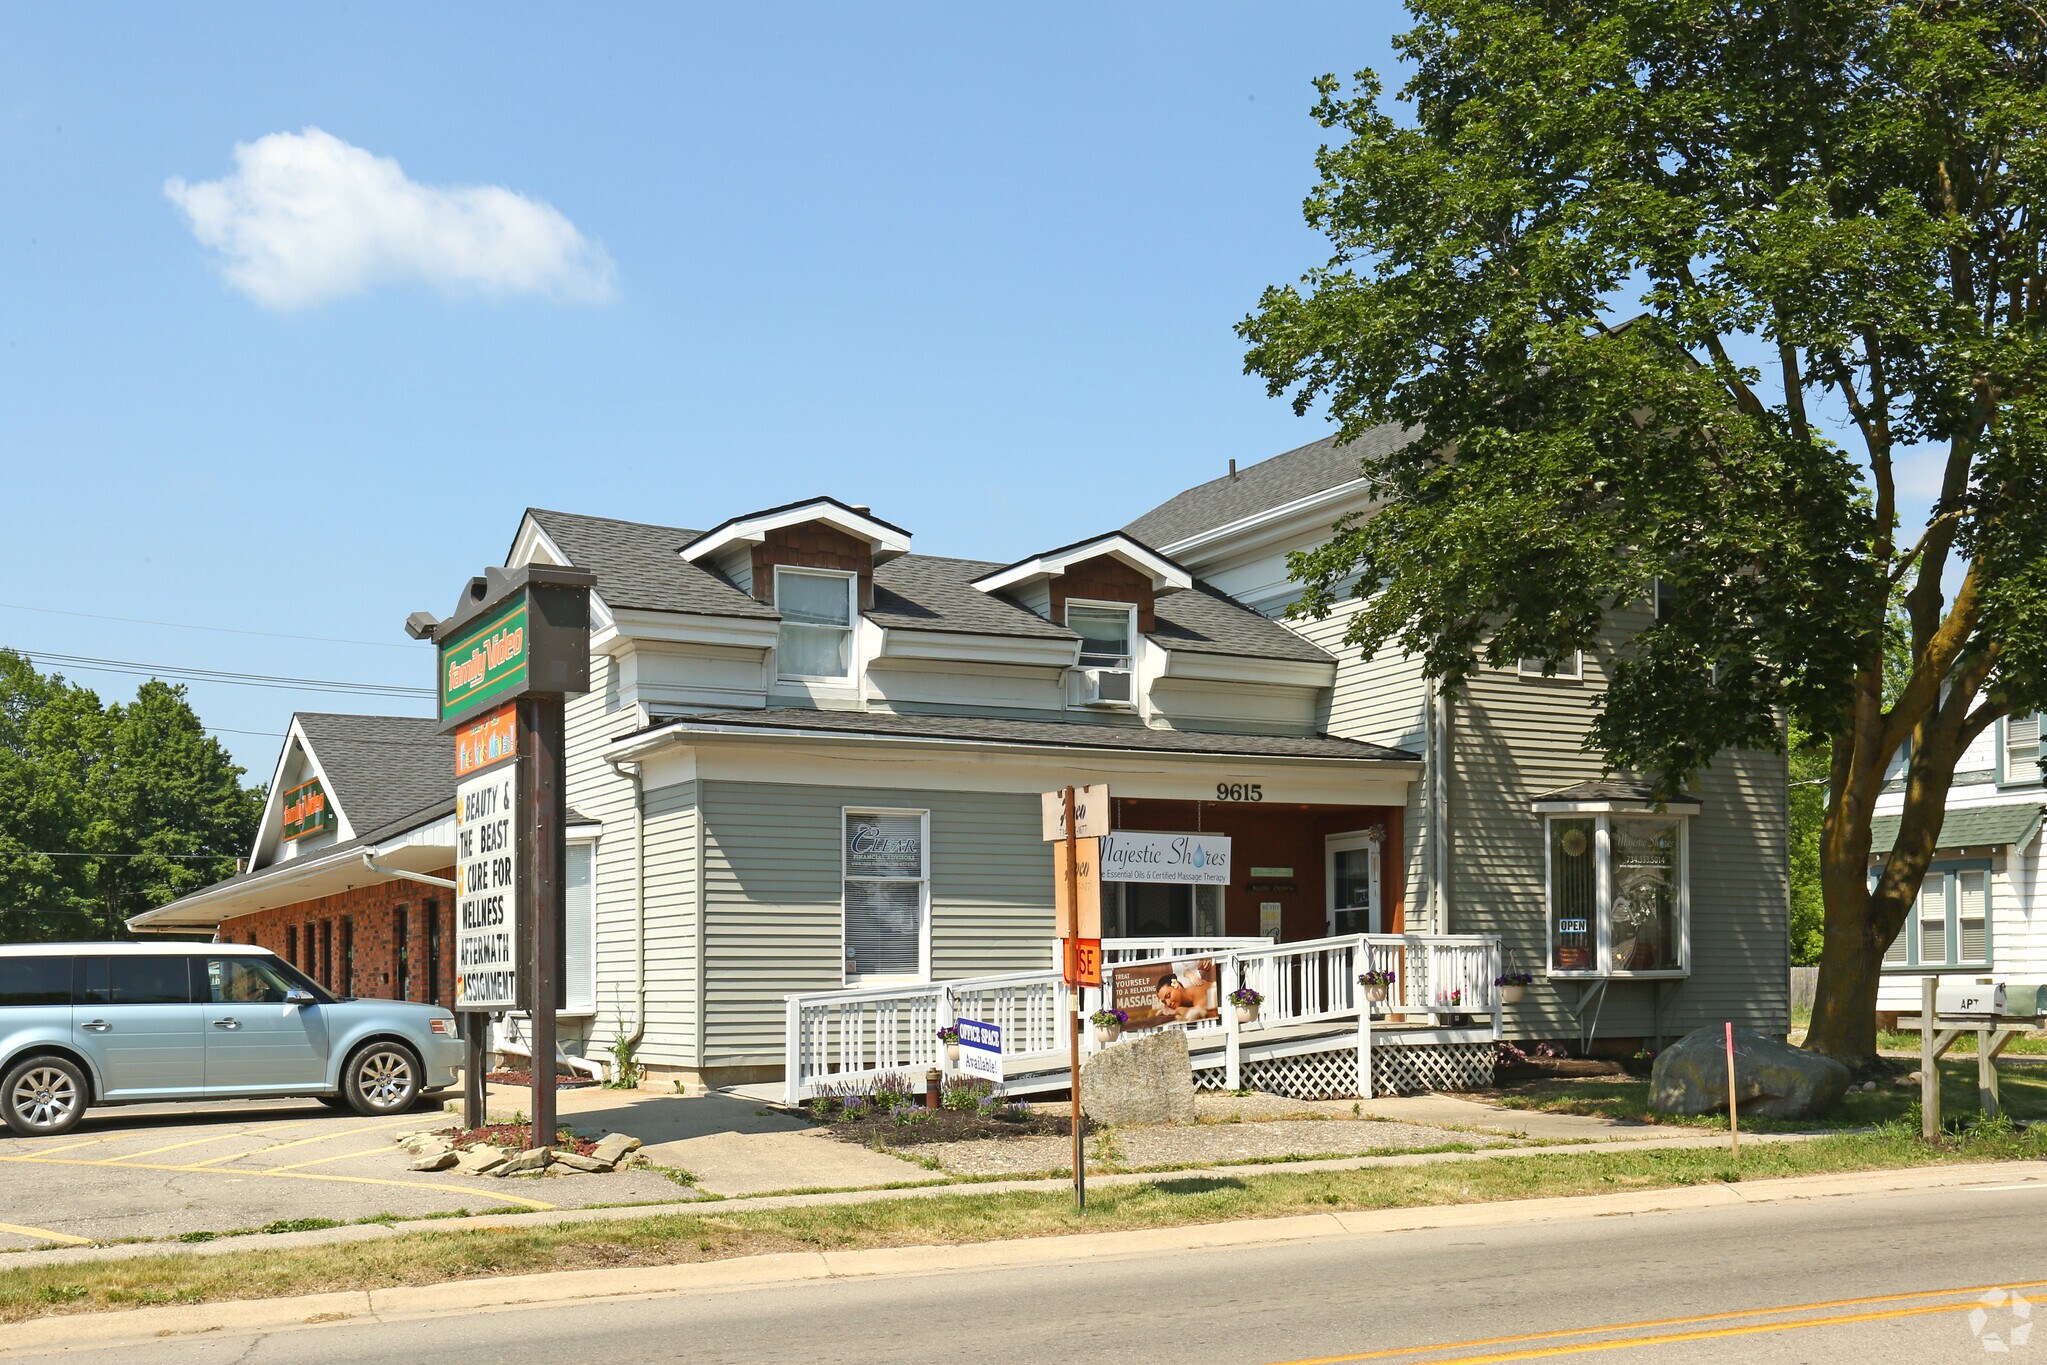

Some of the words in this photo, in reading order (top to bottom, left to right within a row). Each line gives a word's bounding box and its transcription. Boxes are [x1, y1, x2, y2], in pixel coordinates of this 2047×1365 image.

[465, 784, 499, 822] BEAUTY
[504, 781, 510, 810] &
[1216, 782, 1263, 802] 9615
[460, 829, 473, 859] THE
[480, 819, 509, 853] BEAST
[468, 861, 488, 893] CURE
[493, 857, 512, 888] FOR
[1107, 869, 1133, 879] Essential
[1134, 870, 1145, 879] Oils
[1146, 871, 1151, 879] &
[1152, 871, 1176, 880] Certified
[1177, 872, 1202, 882] Massage
[1203, 873, 1227, 883] Therapy
[463, 895, 504, 930] WELLNESS
[1561, 920, 1585, 931] OPEN
[461, 933, 509, 966] AFTERMATH
[464, 971, 515, 1002] ASSIGNMENT
[1115, 978, 1151, 988] YOURSELF
[1130, 985, 1157, 994] RELAXING
[1116, 994, 1158, 1009] MASSAGE
[1961, 998, 1979, 1010] APT
[960, 1023, 980, 1043] OFFICE
[980, 1027, 1000, 1048] SPACE
[965, 1053, 998, 1075] Available!
